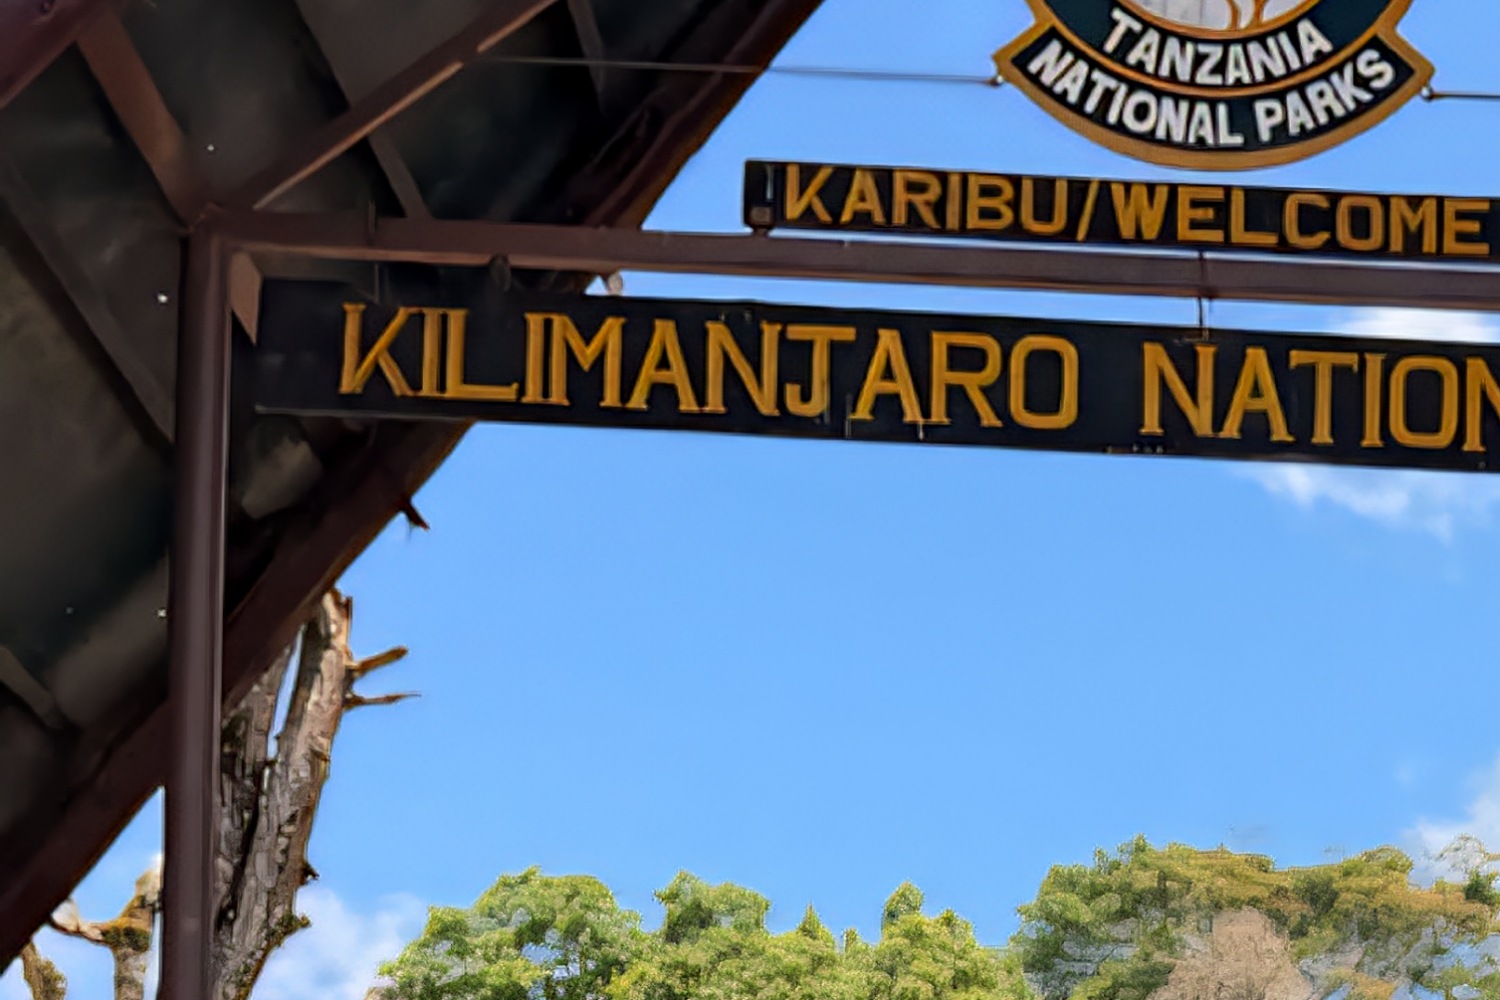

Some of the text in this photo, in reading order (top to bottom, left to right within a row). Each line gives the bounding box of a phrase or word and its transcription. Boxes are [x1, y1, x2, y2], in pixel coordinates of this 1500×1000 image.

[1028, 40, 1395, 146] NATIONAL PARKS
[1103, 9, 1333, 86] TANZANIA
[785, 164, 1490, 256] KARIBU/WELCOME
[339, 301, 1080, 430] KILIMANJARO
